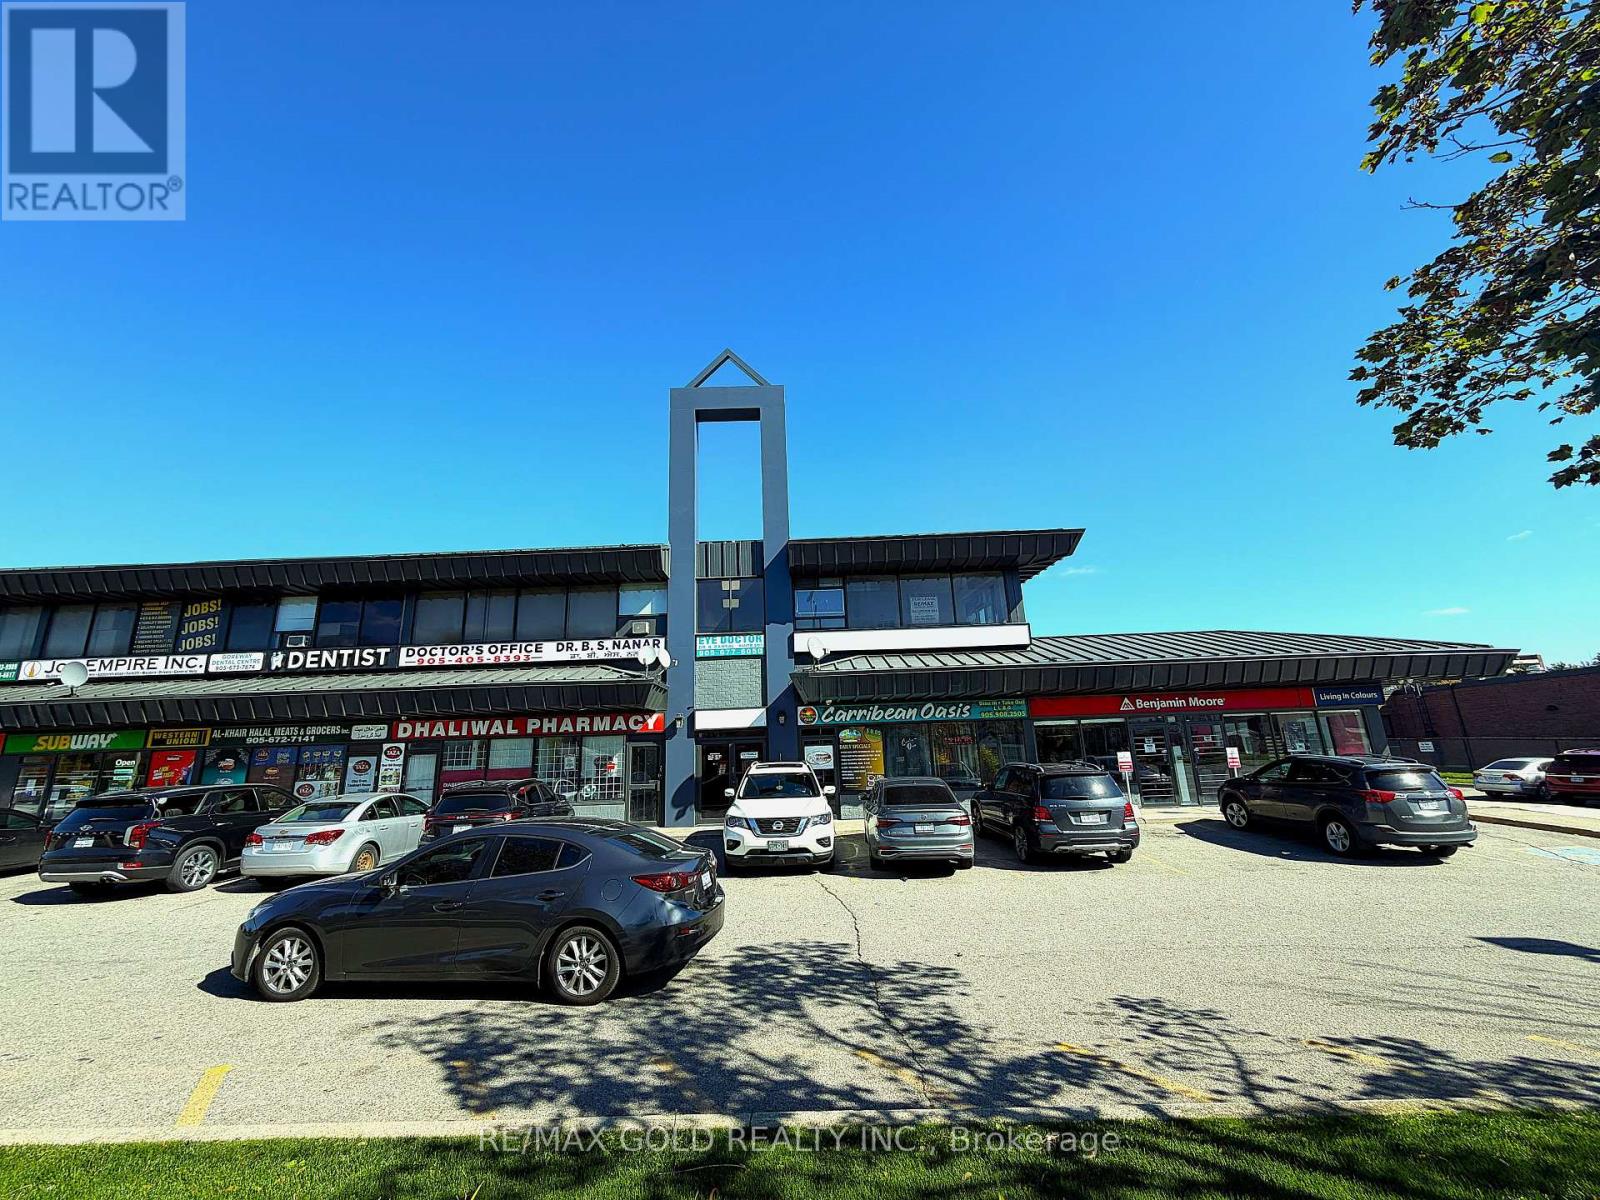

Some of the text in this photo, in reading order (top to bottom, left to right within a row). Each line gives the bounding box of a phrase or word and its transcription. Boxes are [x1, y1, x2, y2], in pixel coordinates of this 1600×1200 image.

[184, 599, 222, 617] JOBS!
[181, 617, 219, 635] JOBS!
[178, 634, 216, 652] JOBS!
[556, 638, 661, 653] DR. B. S. NANAR
[699, 635, 762, 645] EYE DOCTOR
[405, 643, 543, 658] DOCTOR'S OFFICE
[86, 655, 203, 672] EMPIRE INC.
[236, 658, 261, 666] CENTRE
[287, 648, 391, 669] DENTIST
[417, 654, 532, 665] 905-405-8393
[1319, 693, 1342, 701] Living
[1350, 691, 1378, 699] Colours
[1135, 697, 1187, 711] Benjamin
[821, 704, 918, 723] Carribean
[920, 702, 970, 719] Oasis
[212, 728, 247, 738] AL-KHAIR
[248, 727, 273, 737] HALAL
[273, 726, 298, 736] MEATS
[306, 725, 341, 735] GROCERS
[397, 714, 660, 739] DHALIWAL PHARMACY
[32, 733, 118, 751] SUBWAY
[154, 731, 198, 739] WESTERN
[166, 737, 197, 745] UNION
[245, 735, 315, 744] 905-672-7141
[115, 758, 136, 767] Open
